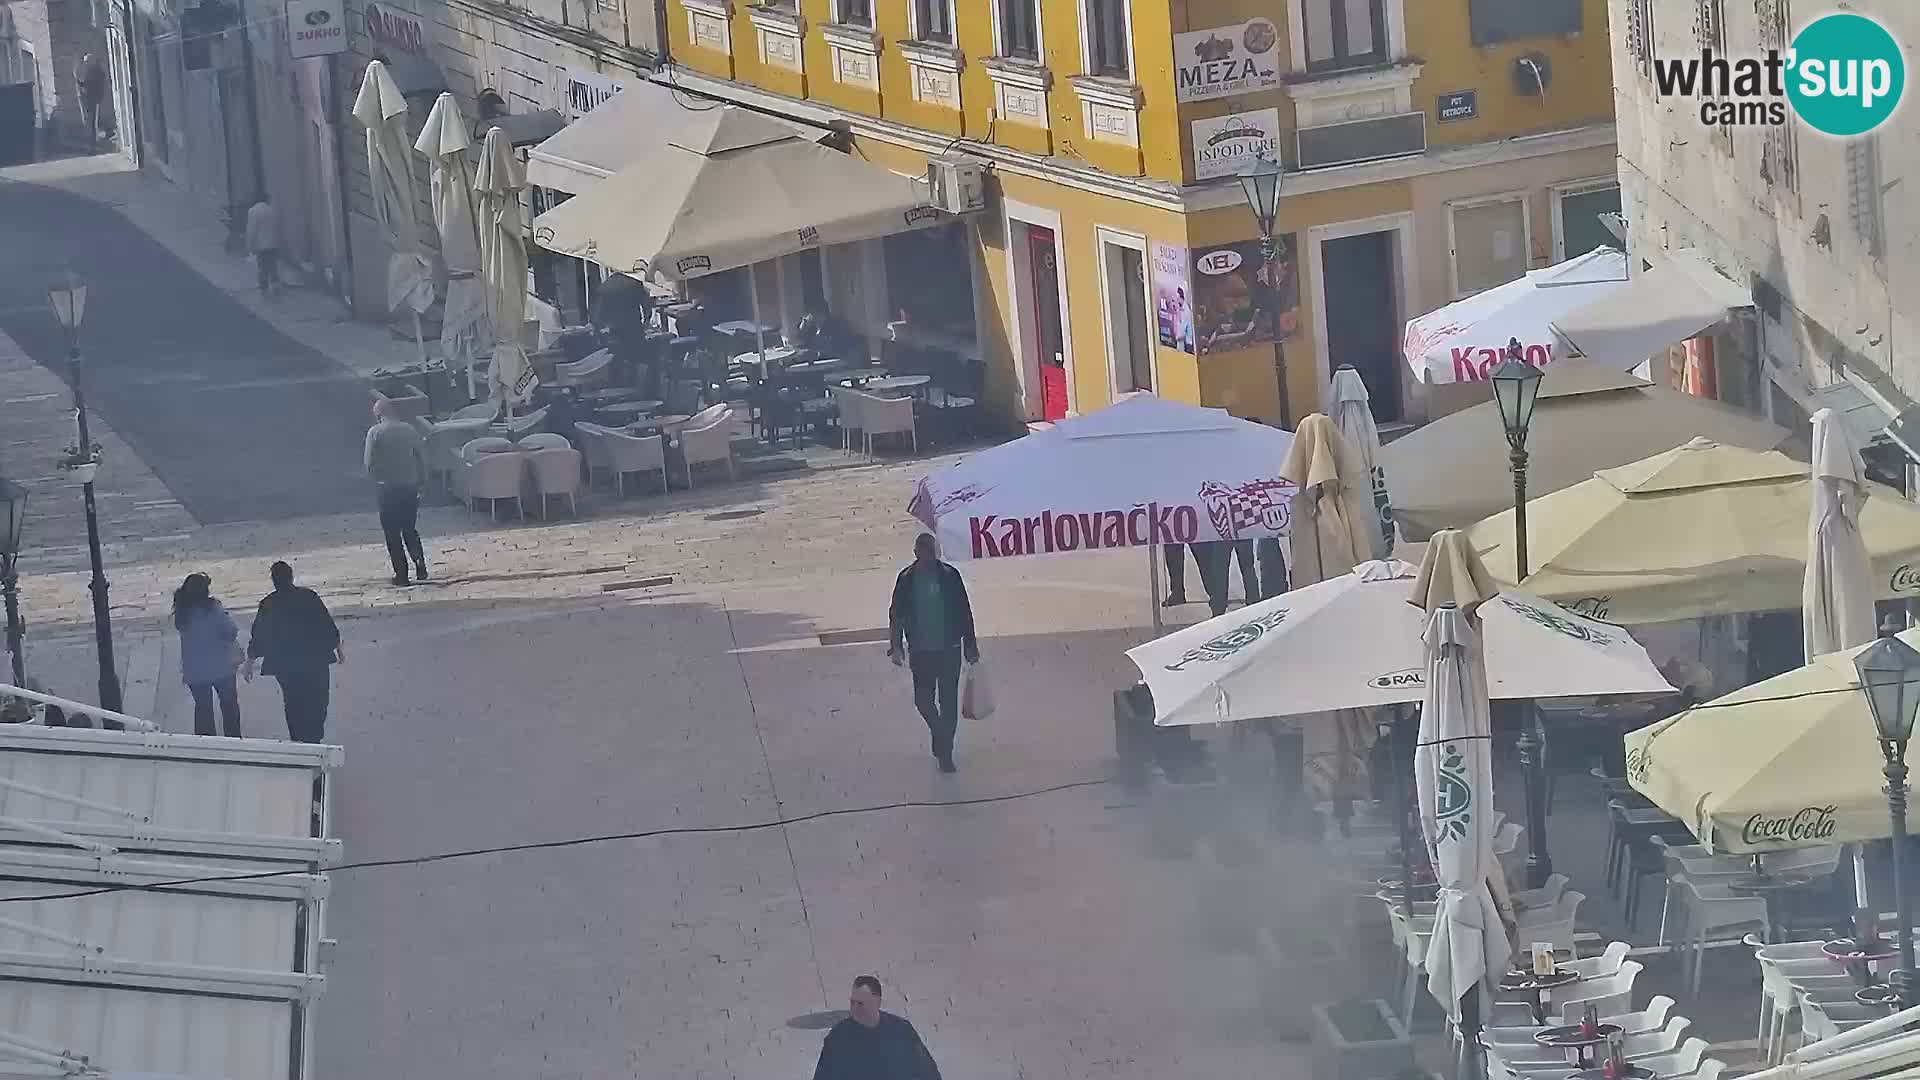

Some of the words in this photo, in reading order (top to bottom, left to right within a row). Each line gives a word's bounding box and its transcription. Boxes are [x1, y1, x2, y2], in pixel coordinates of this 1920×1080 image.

[1180, 58, 1258, 88] MEZA
[1199, 143, 1244, 161] ISPOD
[969, 501, 1199, 559] Karlovačko
